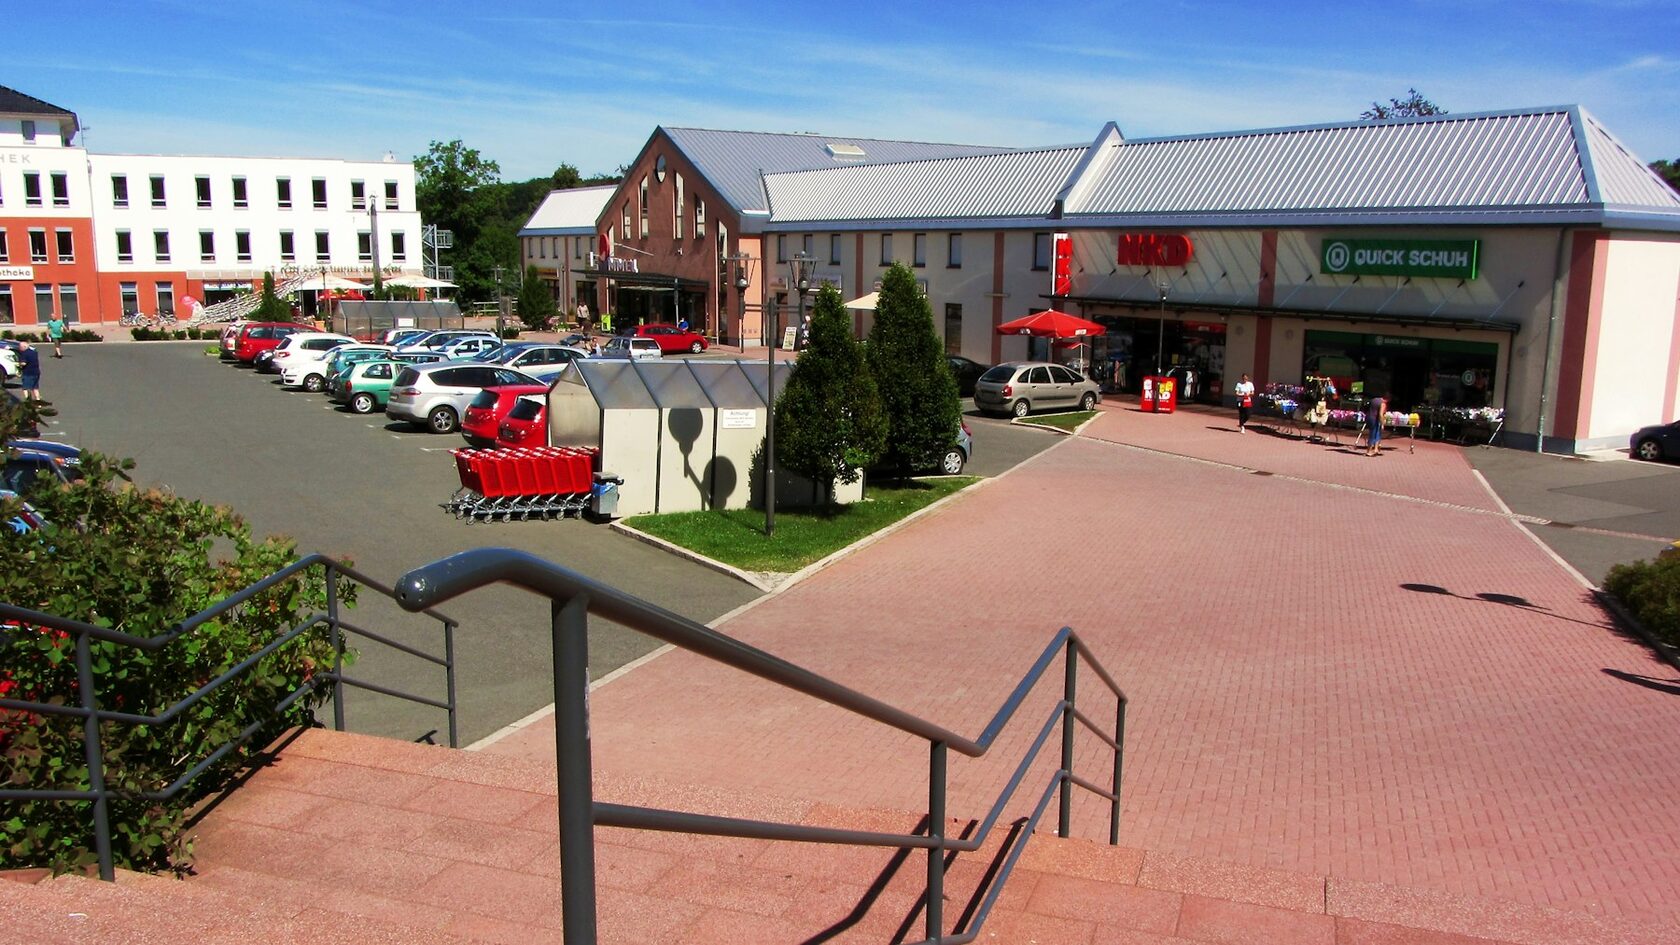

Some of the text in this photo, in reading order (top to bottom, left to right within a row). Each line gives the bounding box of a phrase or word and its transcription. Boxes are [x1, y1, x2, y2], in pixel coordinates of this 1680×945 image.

[1117, 233, 1194, 266] NKD
[1354, 249, 1405, 266] QUICK
[1408, 250, 1468, 267] SCHUH
[0, 268, 31, 277] theke
